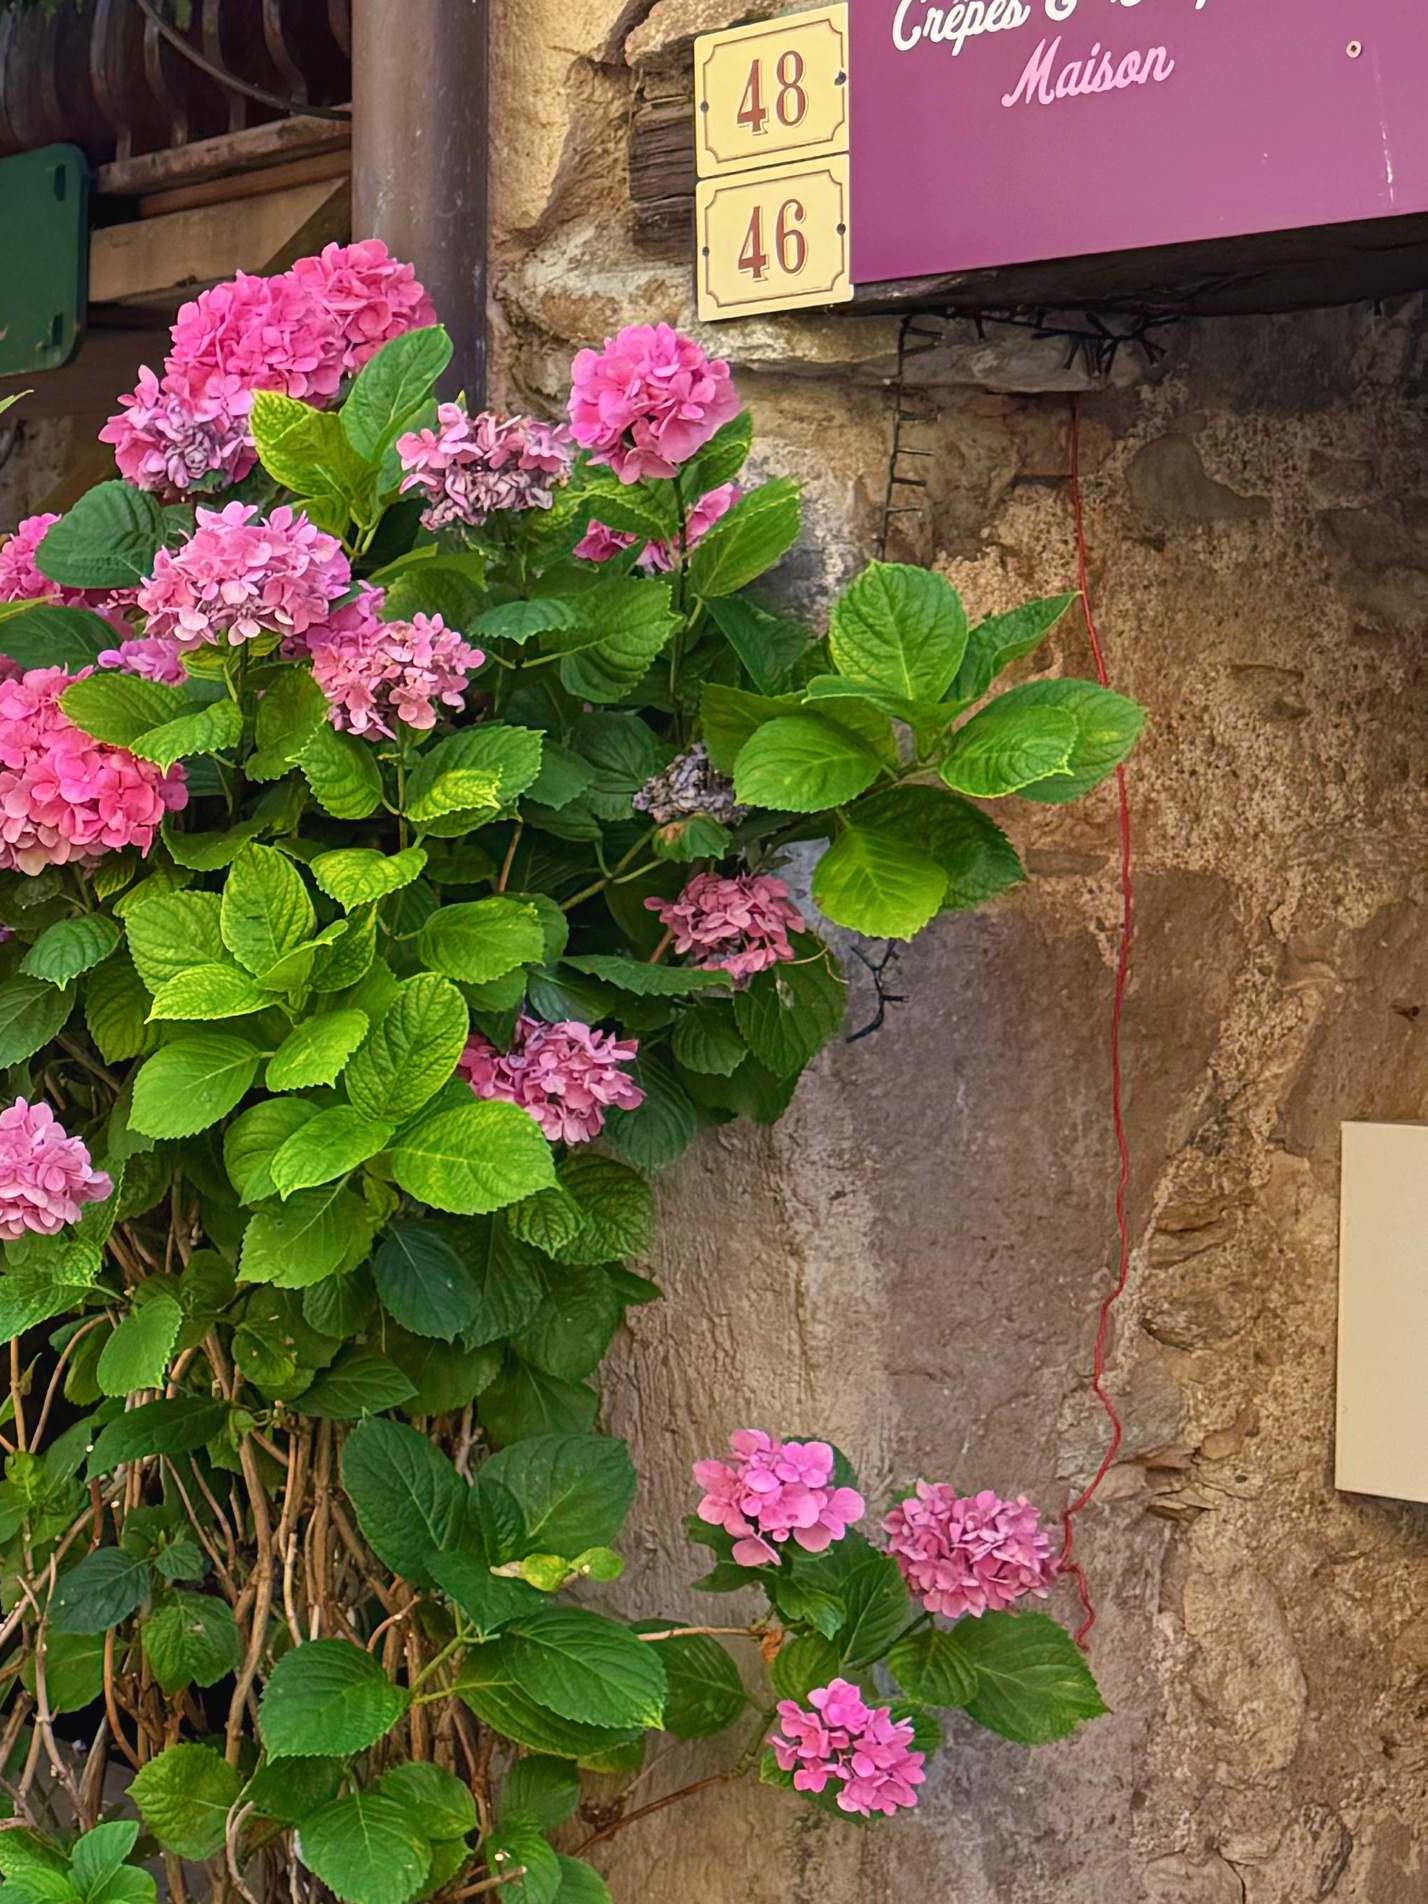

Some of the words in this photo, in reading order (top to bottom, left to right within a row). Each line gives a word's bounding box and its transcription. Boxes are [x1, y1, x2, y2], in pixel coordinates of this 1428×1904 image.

[736, 49, 809, 135] 48
[1001, 36, 1175, 109] Maison
[737, 197, 809, 282] 46
